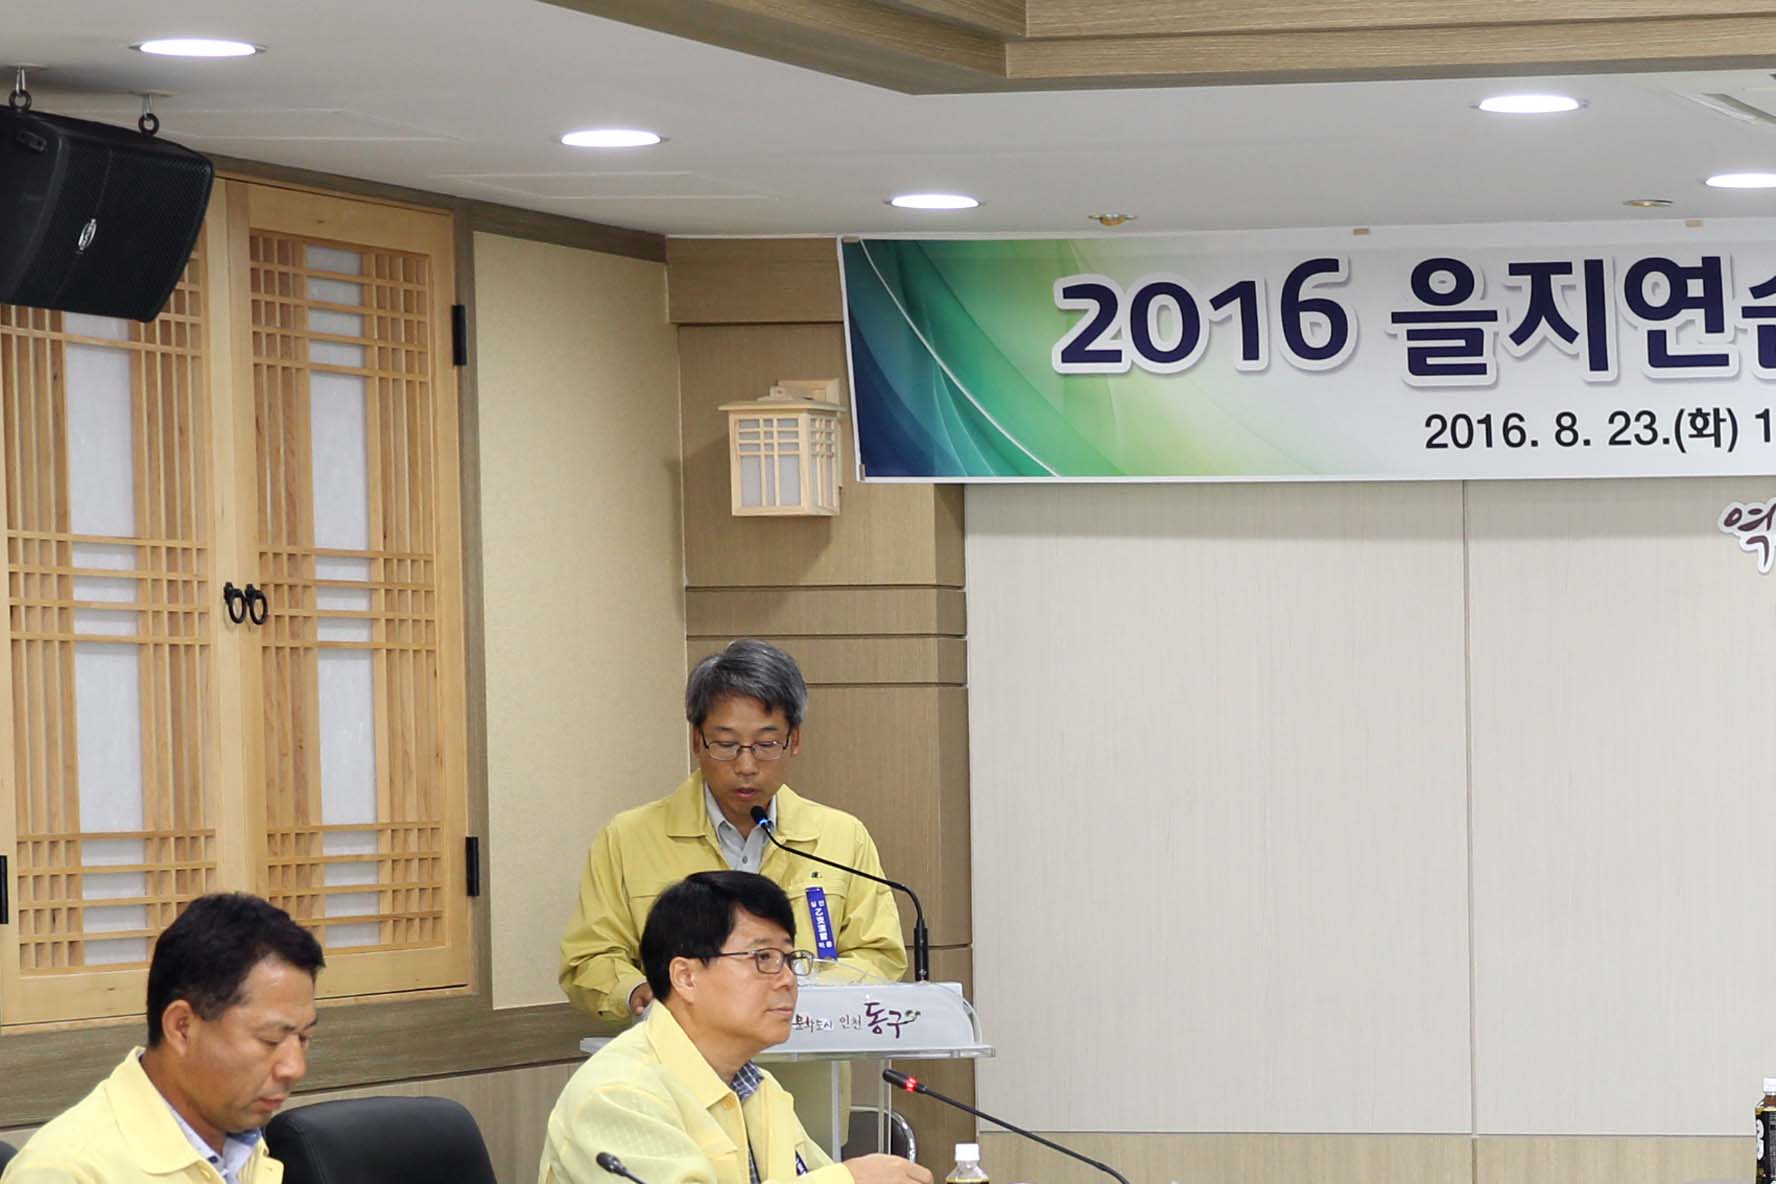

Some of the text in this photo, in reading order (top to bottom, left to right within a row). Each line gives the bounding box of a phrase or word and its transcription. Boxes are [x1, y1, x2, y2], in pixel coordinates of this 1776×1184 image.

[1058, 258, 1349, 366] 2016
[1425, 412, 1540, 449] 2016.
[1555, 411, 1592, 448] 8.
[1608, 407, 1738, 454] 23.(화)
[864, 1002, 905, 1039] 동구
